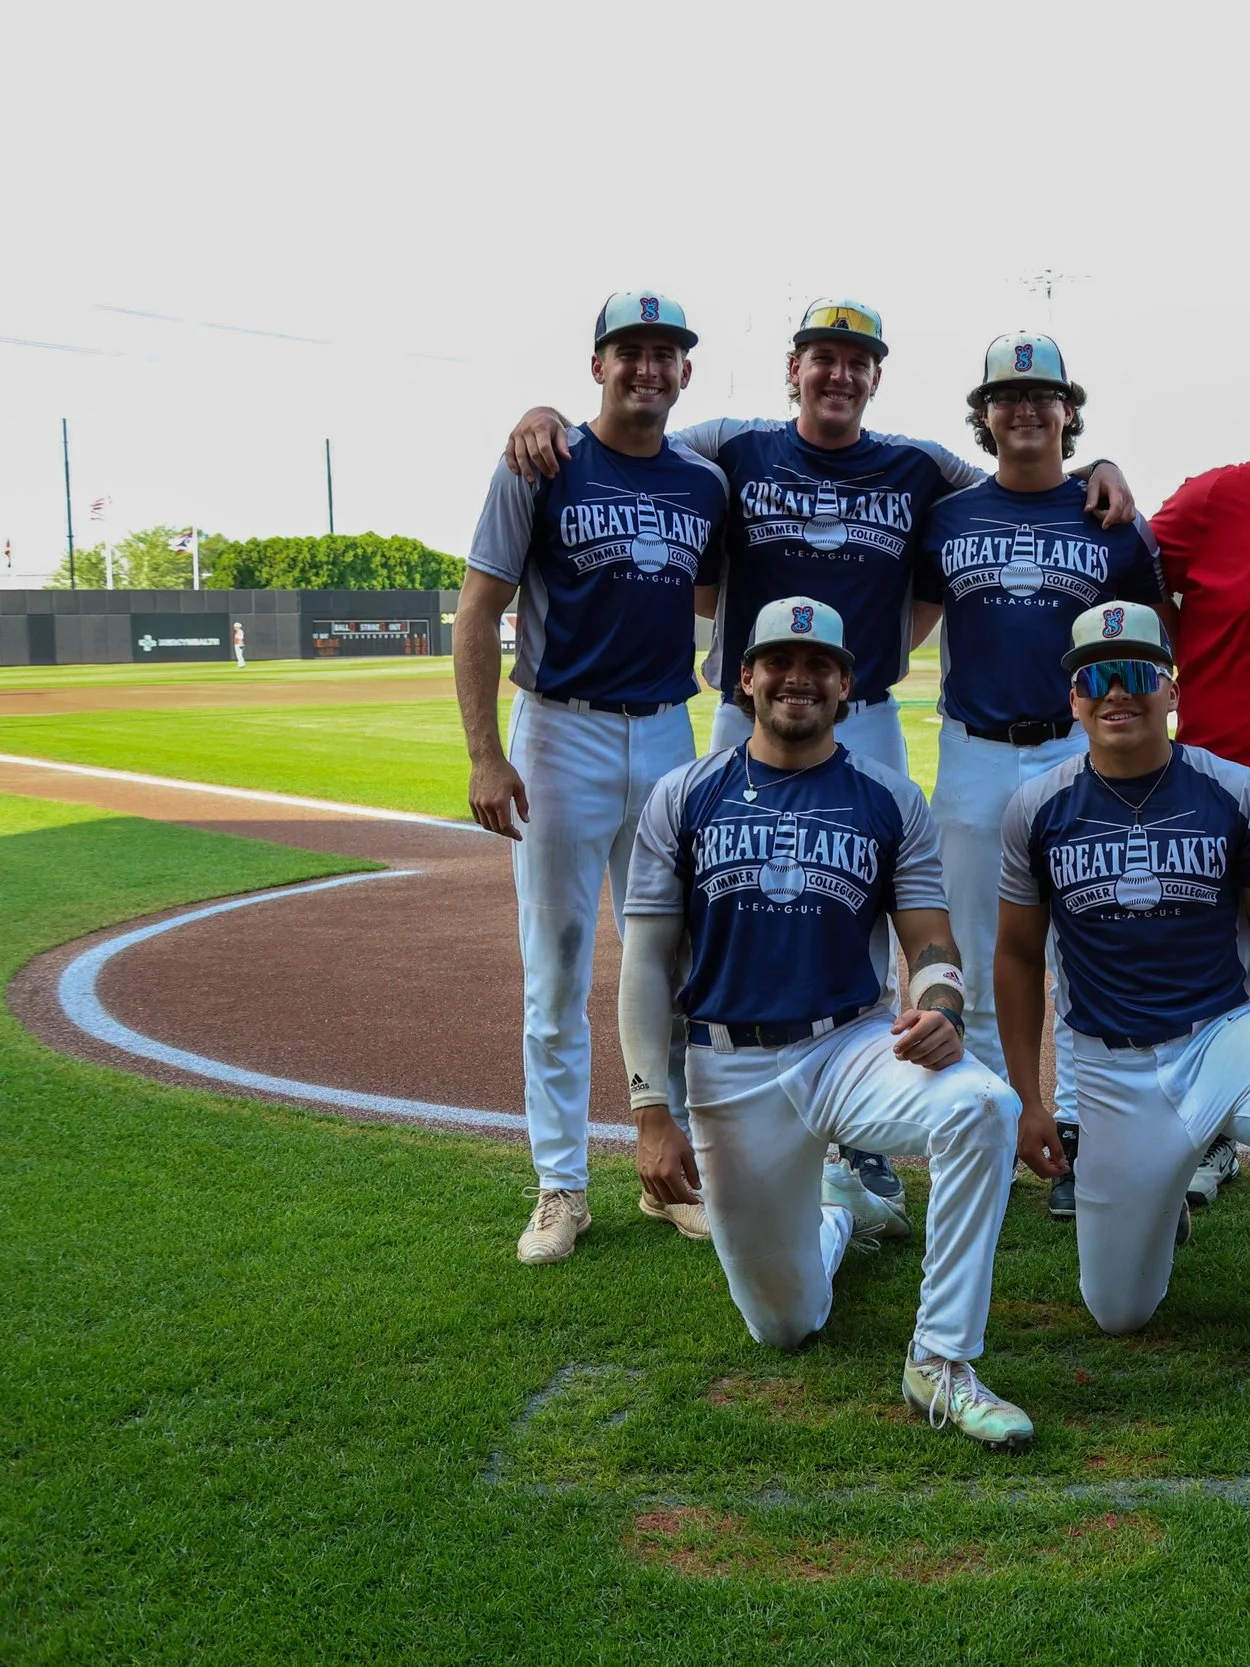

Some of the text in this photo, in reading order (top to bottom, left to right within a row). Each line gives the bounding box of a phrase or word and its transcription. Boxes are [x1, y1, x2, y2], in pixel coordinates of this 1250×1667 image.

[560, 505, 636, 548] GREAT
[740, 481, 912, 532] GREAT LAKES
[577, 544, 627, 568] SUMMER
[750, 525, 903, 554] SUMMER COLLEGIATE
[941, 536, 1108, 583] GREAT LAKES
[953, 572, 1097, 601] SUMMER COLLEGIATE
[692, 825, 879, 884] GREAT LAKES
[1050, 836, 1227, 890] GREAT LAKES
[1067, 887, 1111, 911] SUMMER
